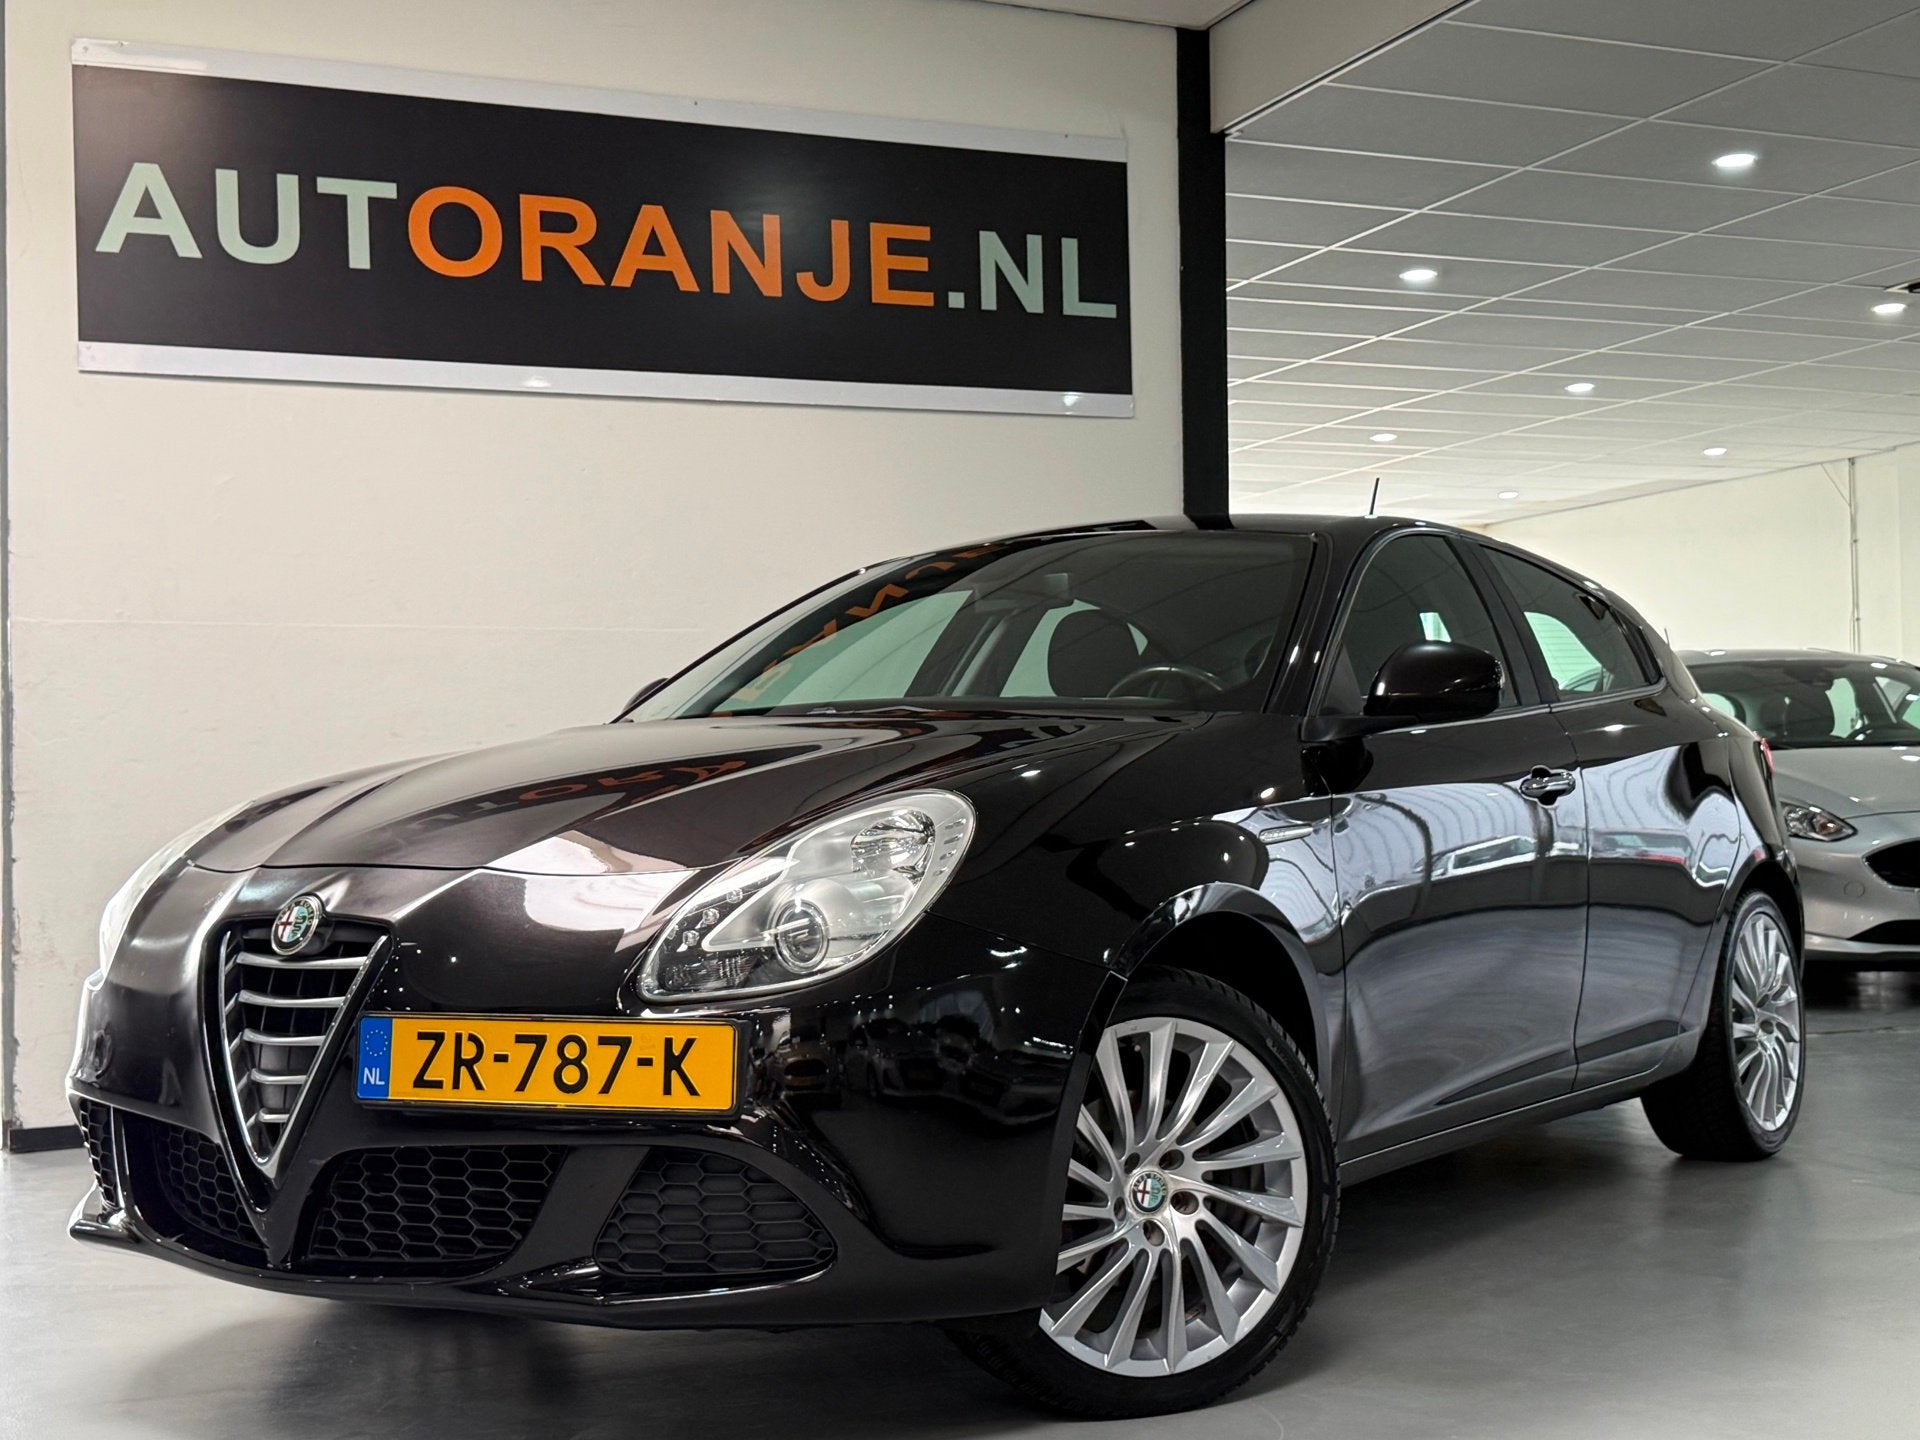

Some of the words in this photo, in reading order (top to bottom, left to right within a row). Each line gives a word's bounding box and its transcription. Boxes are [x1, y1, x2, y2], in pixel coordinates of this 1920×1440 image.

[95, 161, 1118, 319] AUTORANJE.NL
[362, 1066, 386, 1086] NL
[412, 1031, 701, 1096] ZR-787-K
